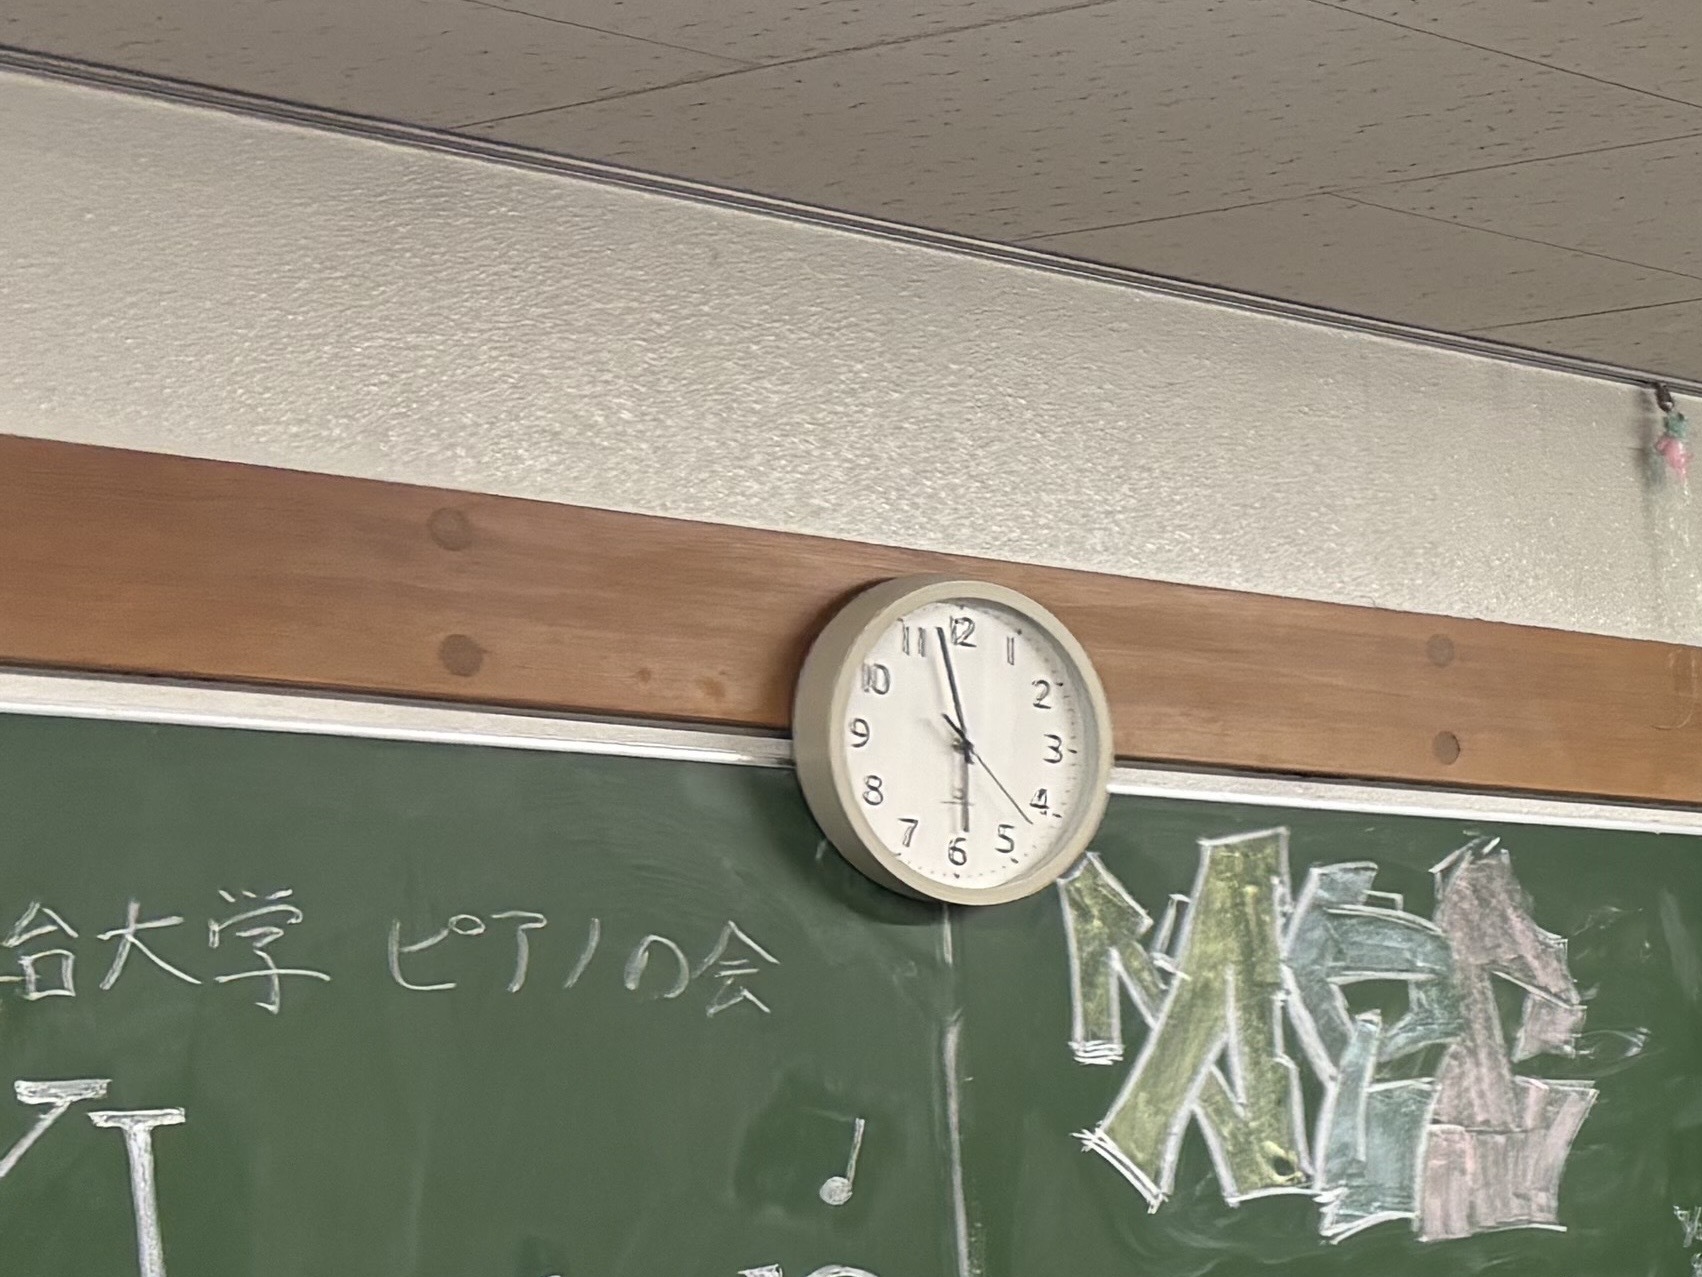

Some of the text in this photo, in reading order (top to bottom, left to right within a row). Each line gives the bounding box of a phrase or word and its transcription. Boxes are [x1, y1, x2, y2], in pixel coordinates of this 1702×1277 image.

[901, 626, 926, 657] 11
[950, 616, 977, 648] 12
[1006, 637, 1015, 665] 1
[862, 663, 891, 695] 10
[1032, 679, 1051, 709] 2
[850, 718, 870, 748] 9
[1043, 734, 1063, 763] 3
[863, 775, 884, 806] 8
[1029, 788, 1049, 810] 4
[899, 818, 918, 847] 7
[995, 824, 1015, 853] 5
[948, 837, 967, 866] 6
